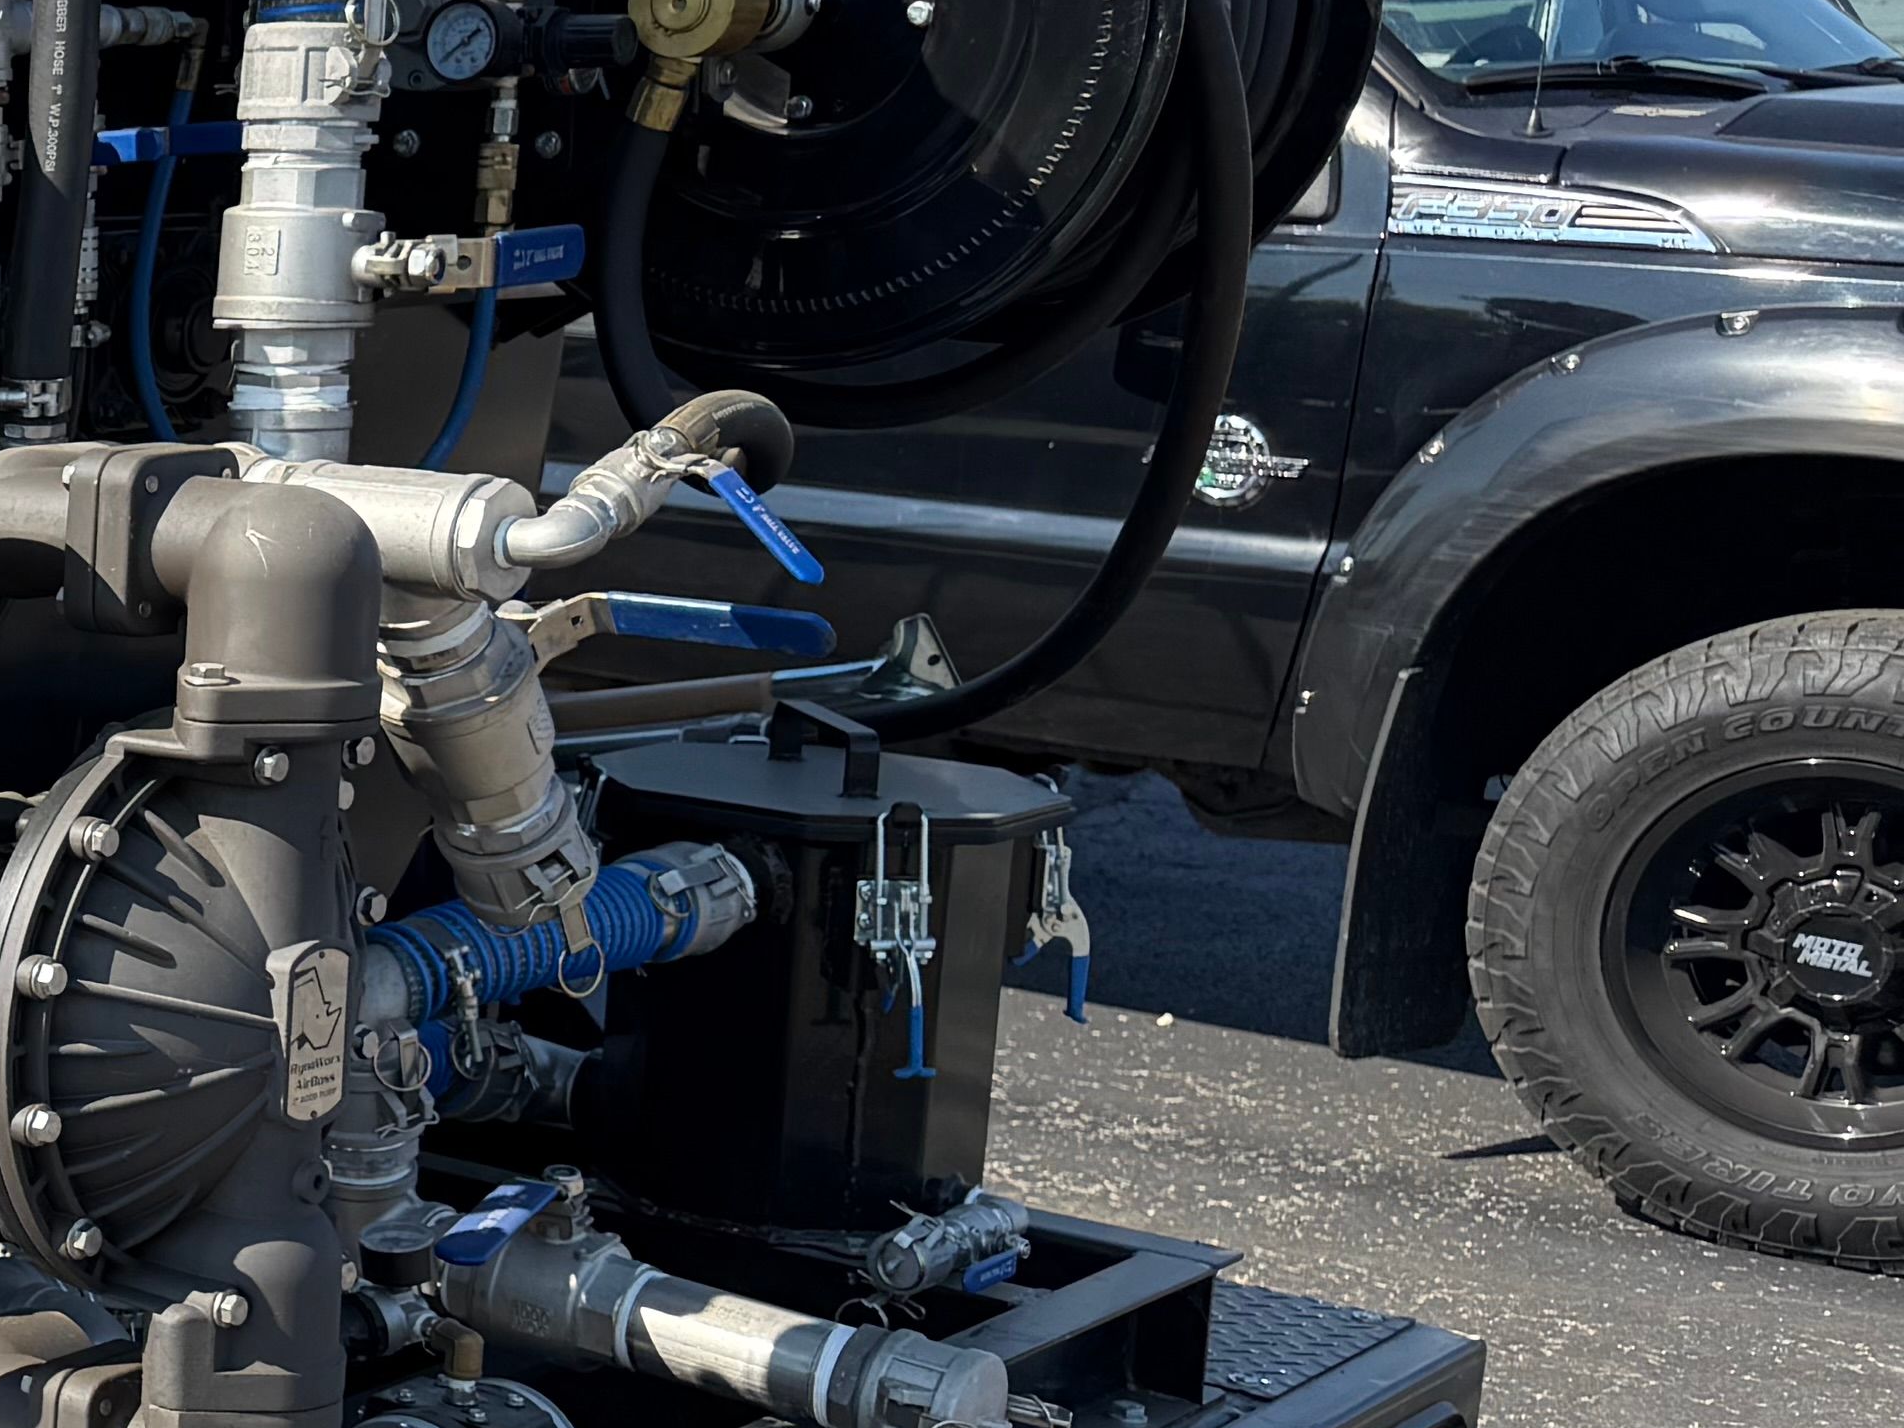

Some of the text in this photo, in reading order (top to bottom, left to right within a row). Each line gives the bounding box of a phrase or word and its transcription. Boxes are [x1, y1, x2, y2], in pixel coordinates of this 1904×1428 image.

[52, 40, 67, 76] HOSE
[1792, 932, 1864, 960] MOTO
[1796, 946, 1873, 978] METAL
